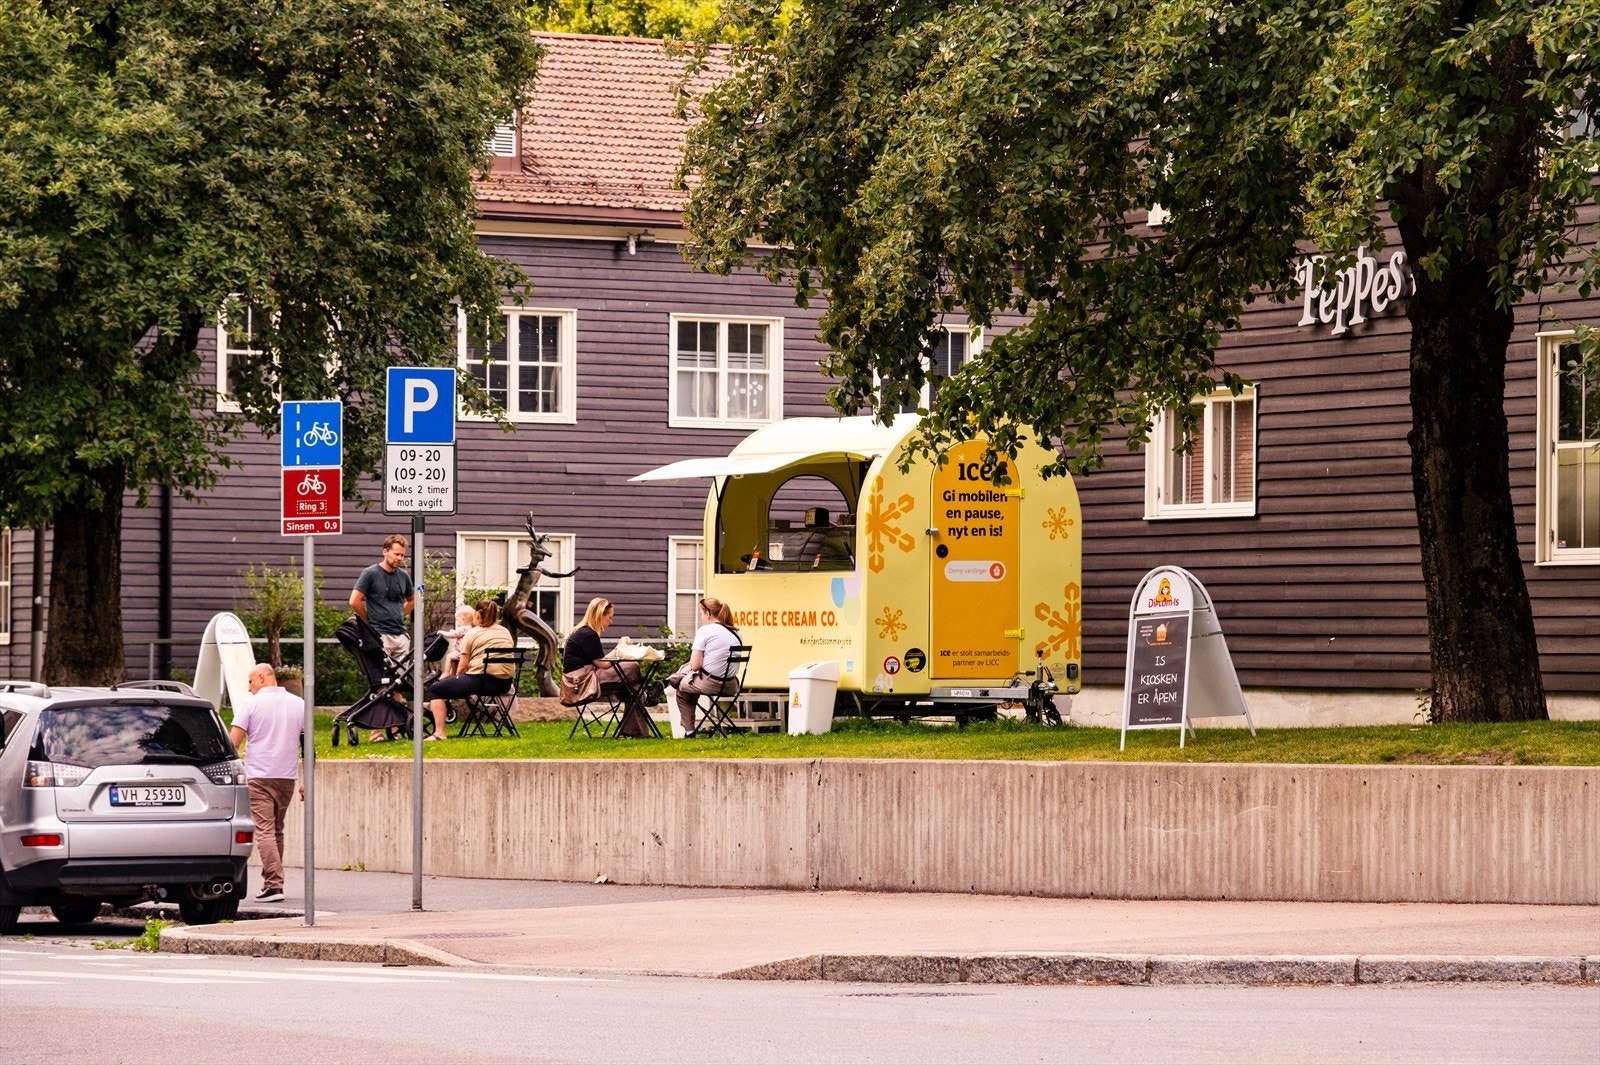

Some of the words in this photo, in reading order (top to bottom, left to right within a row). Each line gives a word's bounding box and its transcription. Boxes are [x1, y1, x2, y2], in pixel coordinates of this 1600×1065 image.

[1294, 246, 1407, 335] Peppes
[404, 378, 438, 434] P
[400, 449, 441, 462] 09-20
[394, 468, 446, 482] (09-20)
[390, 485, 413, 494] Maks
[417, 486, 423, 494] 2
[427, 485, 449, 494] timer
[942, 490, 956, 502] Gi
[958, 490, 1008, 502] mobilen
[299, 502, 317, 512] Ring
[319, 502, 325, 510] 3
[396, 498, 414, 507] mot
[418, 498, 443, 508] avgift
[946, 509, 962, 519] en
[964, 509, 1004, 522] pause,
[286, 522, 315, 531] Sinsen
[948, 526, 969, 540] nyt
[971, 526, 986, 537] en
[989, 525, 1003, 537] is!
[732, 610, 759, 626] ARGE
[762, 610, 778, 626] ICE
[781, 610, 817, 626] CREAM
[820, 610, 838, 626] CO.
[1155, 656, 1166, 666] IS
[1140, 673, 1178, 686] KIOSKEN
[1138, 693, 1150, 704] ER
[1153, 688, 1178, 706] ÅPEN!
[121, 789, 138, 801] VH
[145, 789, 182, 801] 25930
